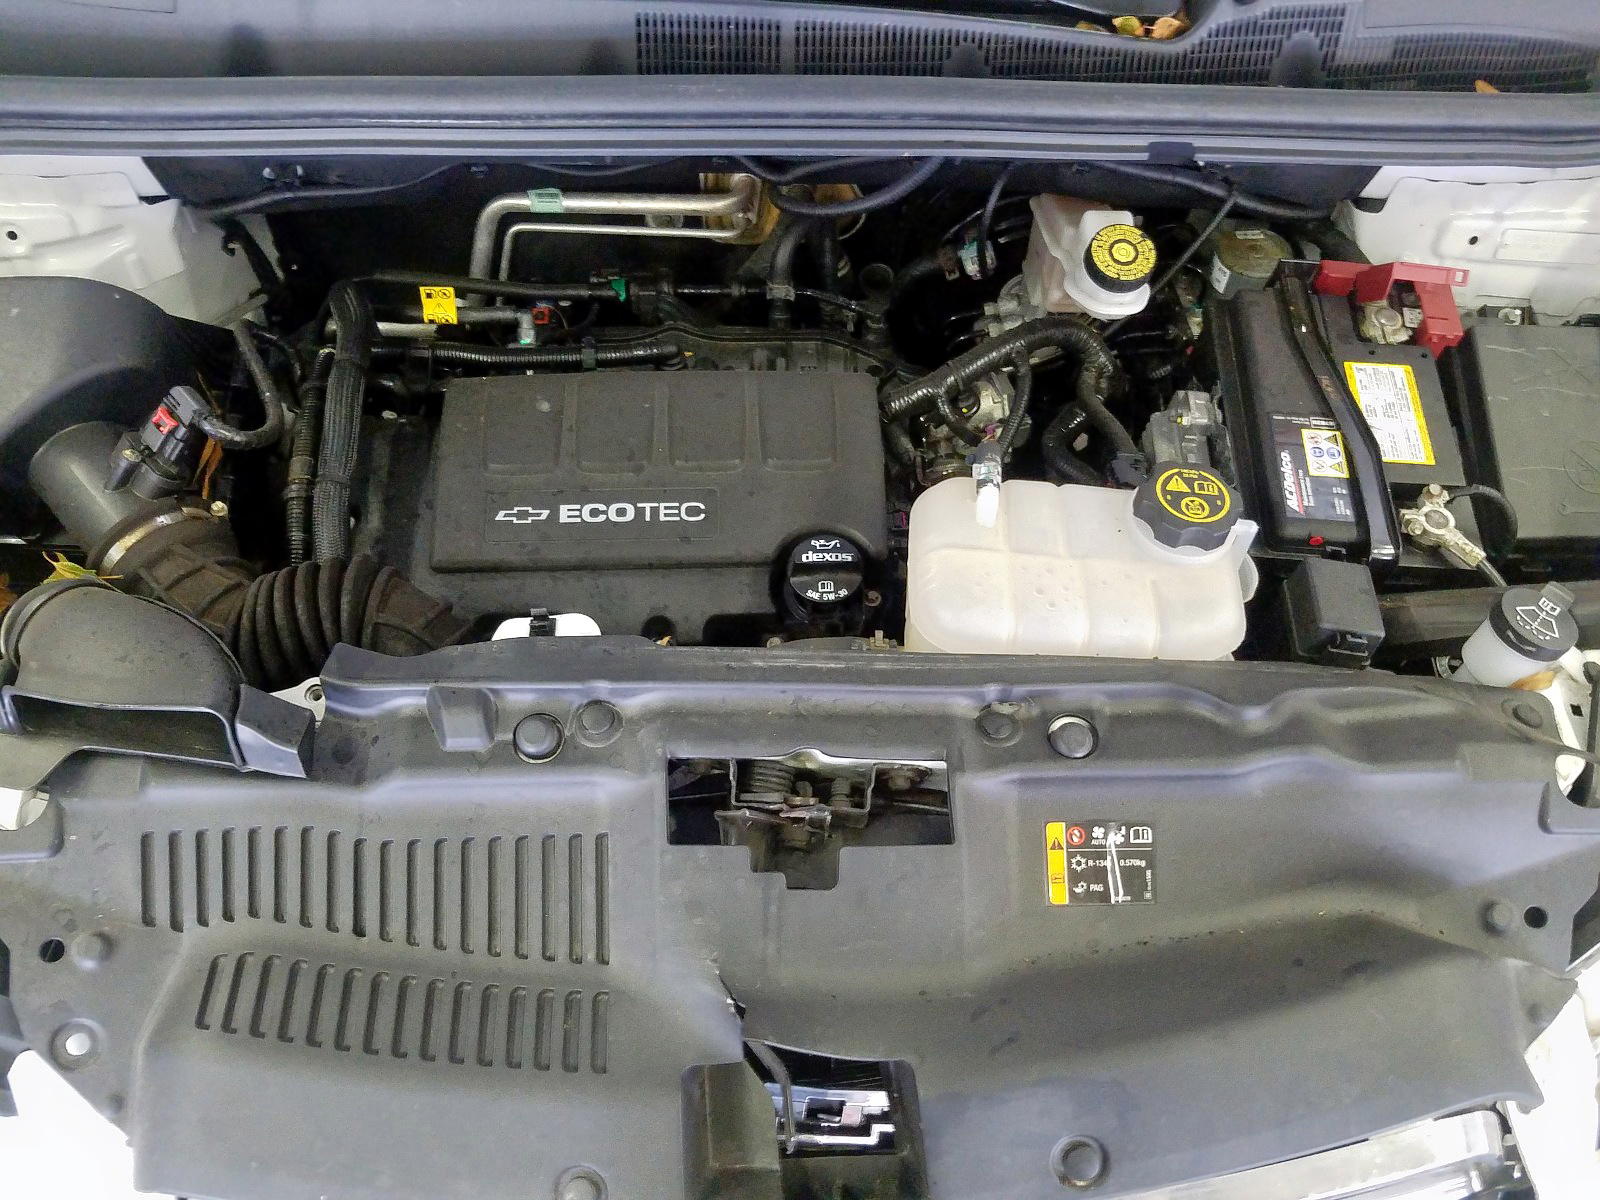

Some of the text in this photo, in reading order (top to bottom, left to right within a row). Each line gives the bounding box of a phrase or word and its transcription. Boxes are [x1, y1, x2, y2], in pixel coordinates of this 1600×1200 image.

[1280, 451, 1301, 512] ACDelco
[559, 502, 706, 523] ECOTEC
[801, 550, 853, 562] dexos
[806, 588, 848, 601] SAE 5W-30
[1091, 838, 1106, 846] AUTO
[1087, 859, 1111, 868] R-134
[1089, 883, 1104, 892] PAG
